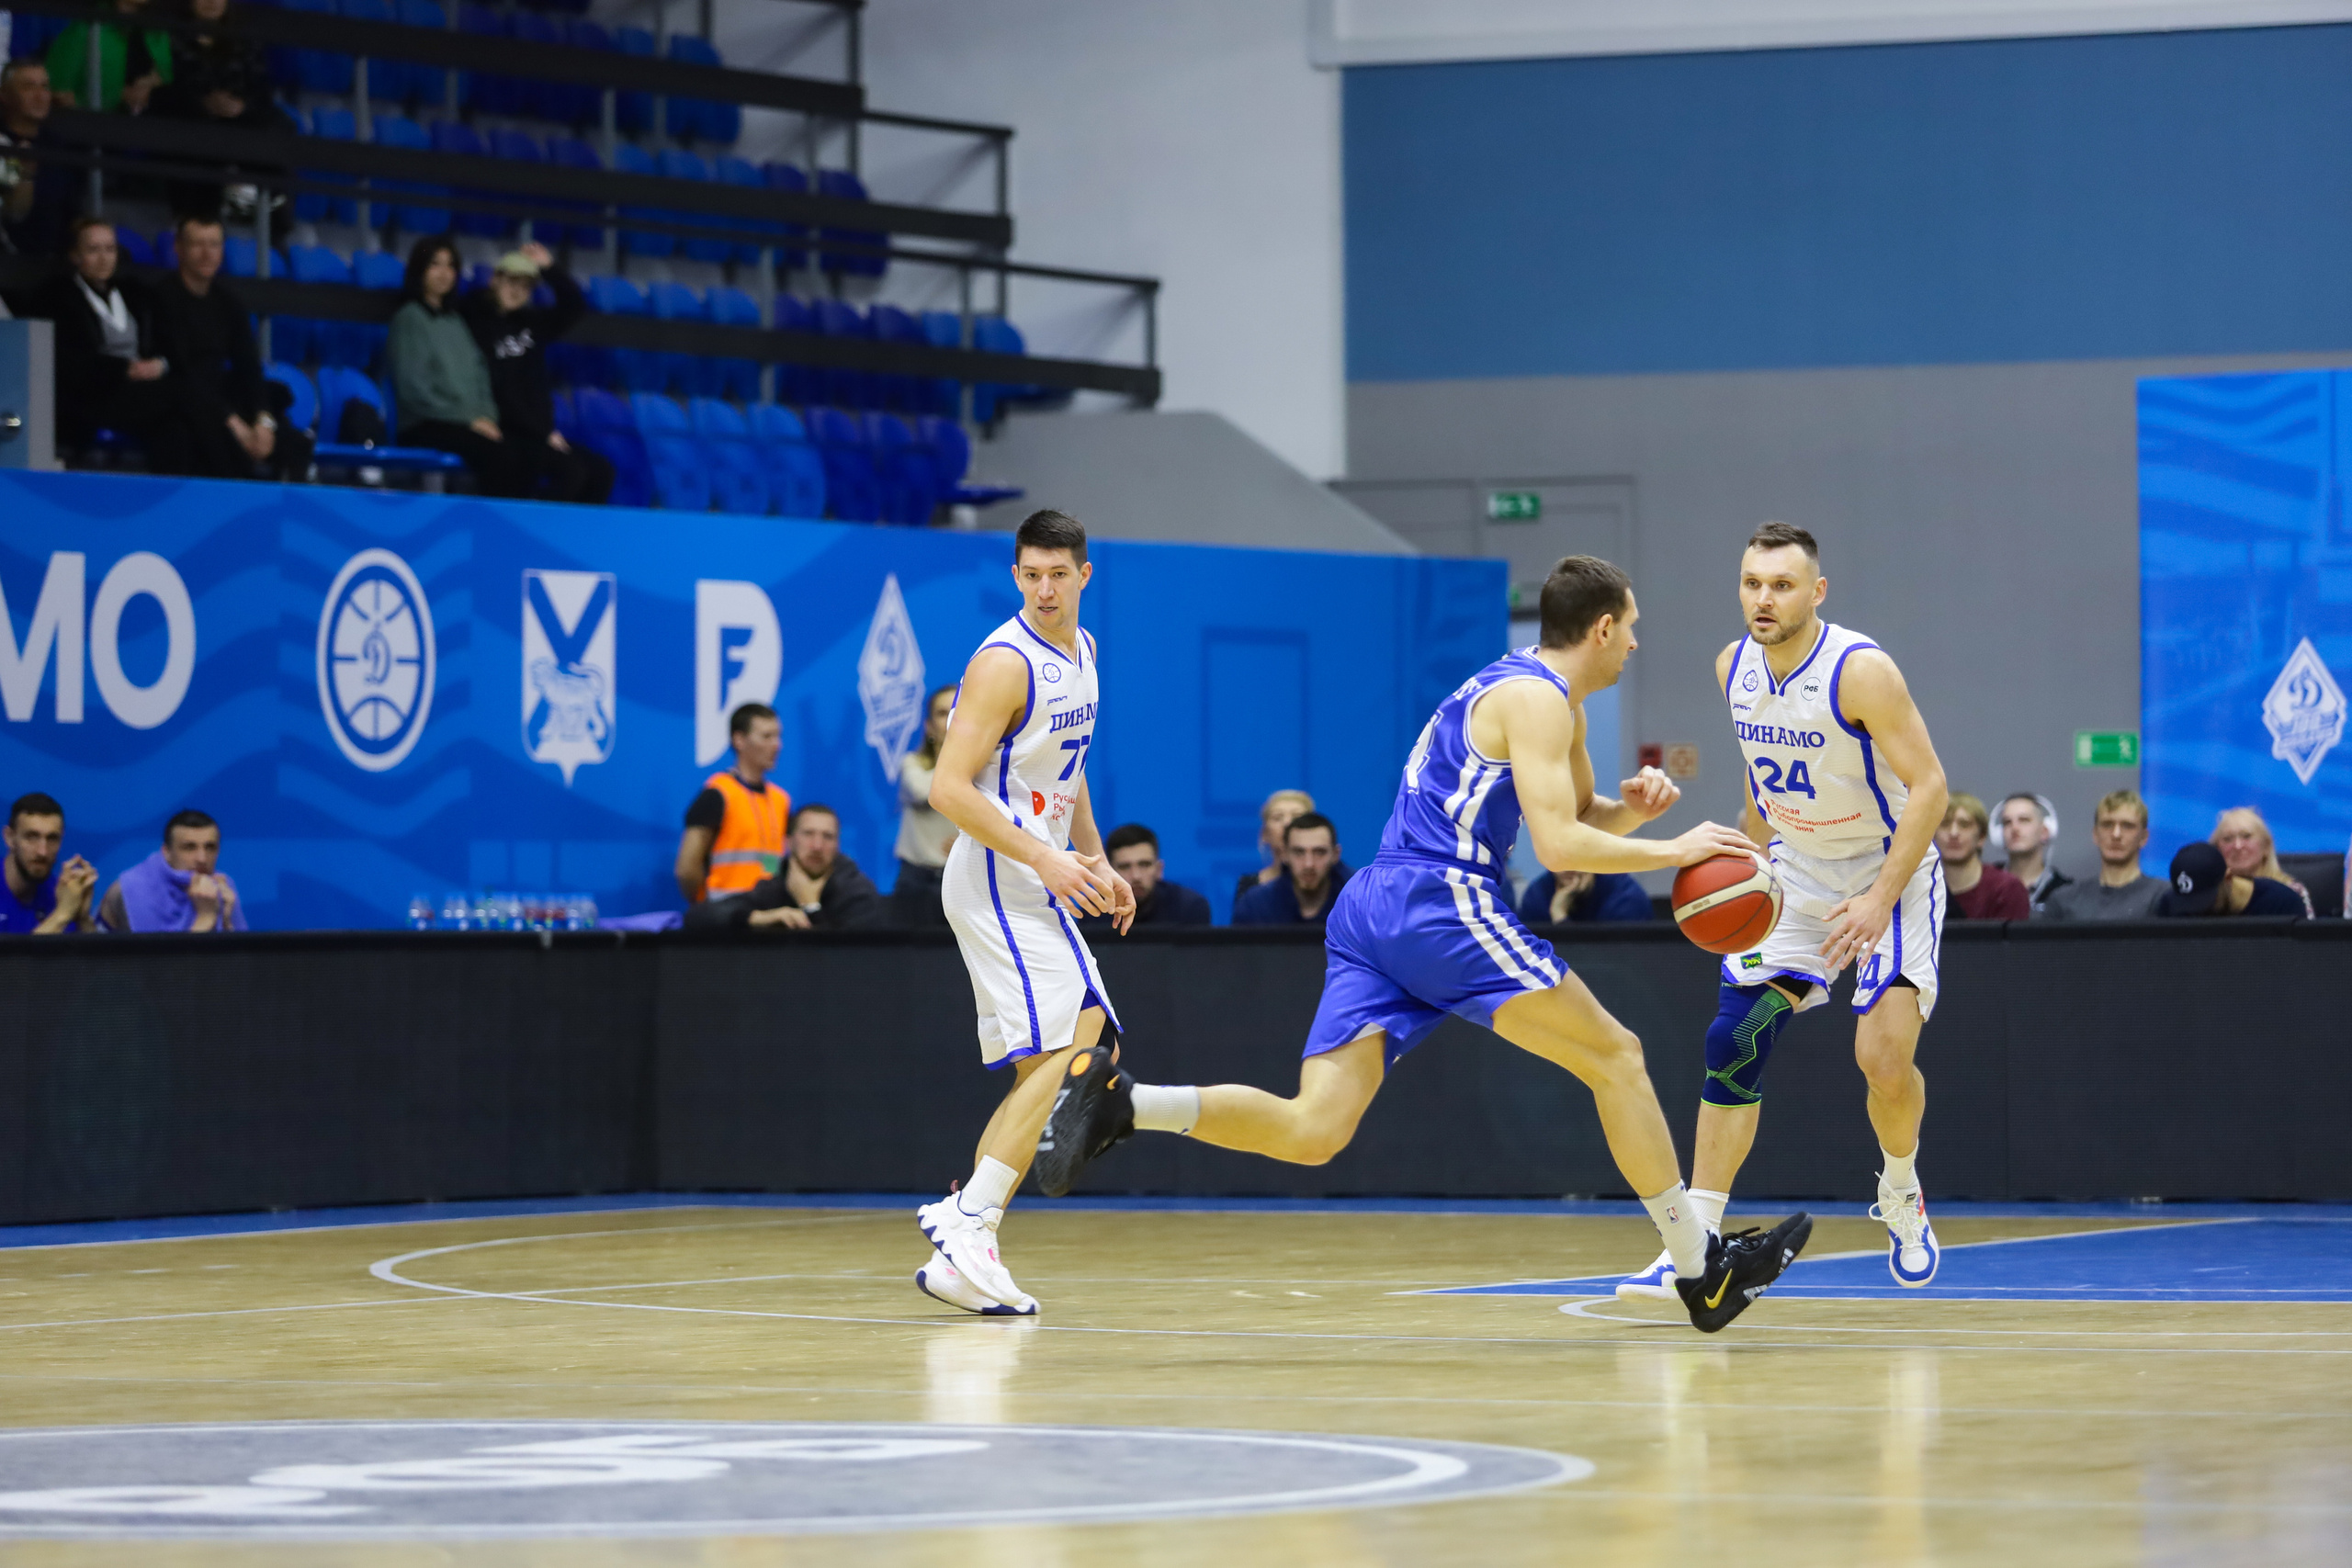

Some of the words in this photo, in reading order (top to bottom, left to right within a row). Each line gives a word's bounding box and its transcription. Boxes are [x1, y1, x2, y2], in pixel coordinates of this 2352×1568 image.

[1735, 720, 1825, 748] ДИНАМО
[1057, 735, 1091, 781] 77
[1754, 756, 1816, 799] 24
